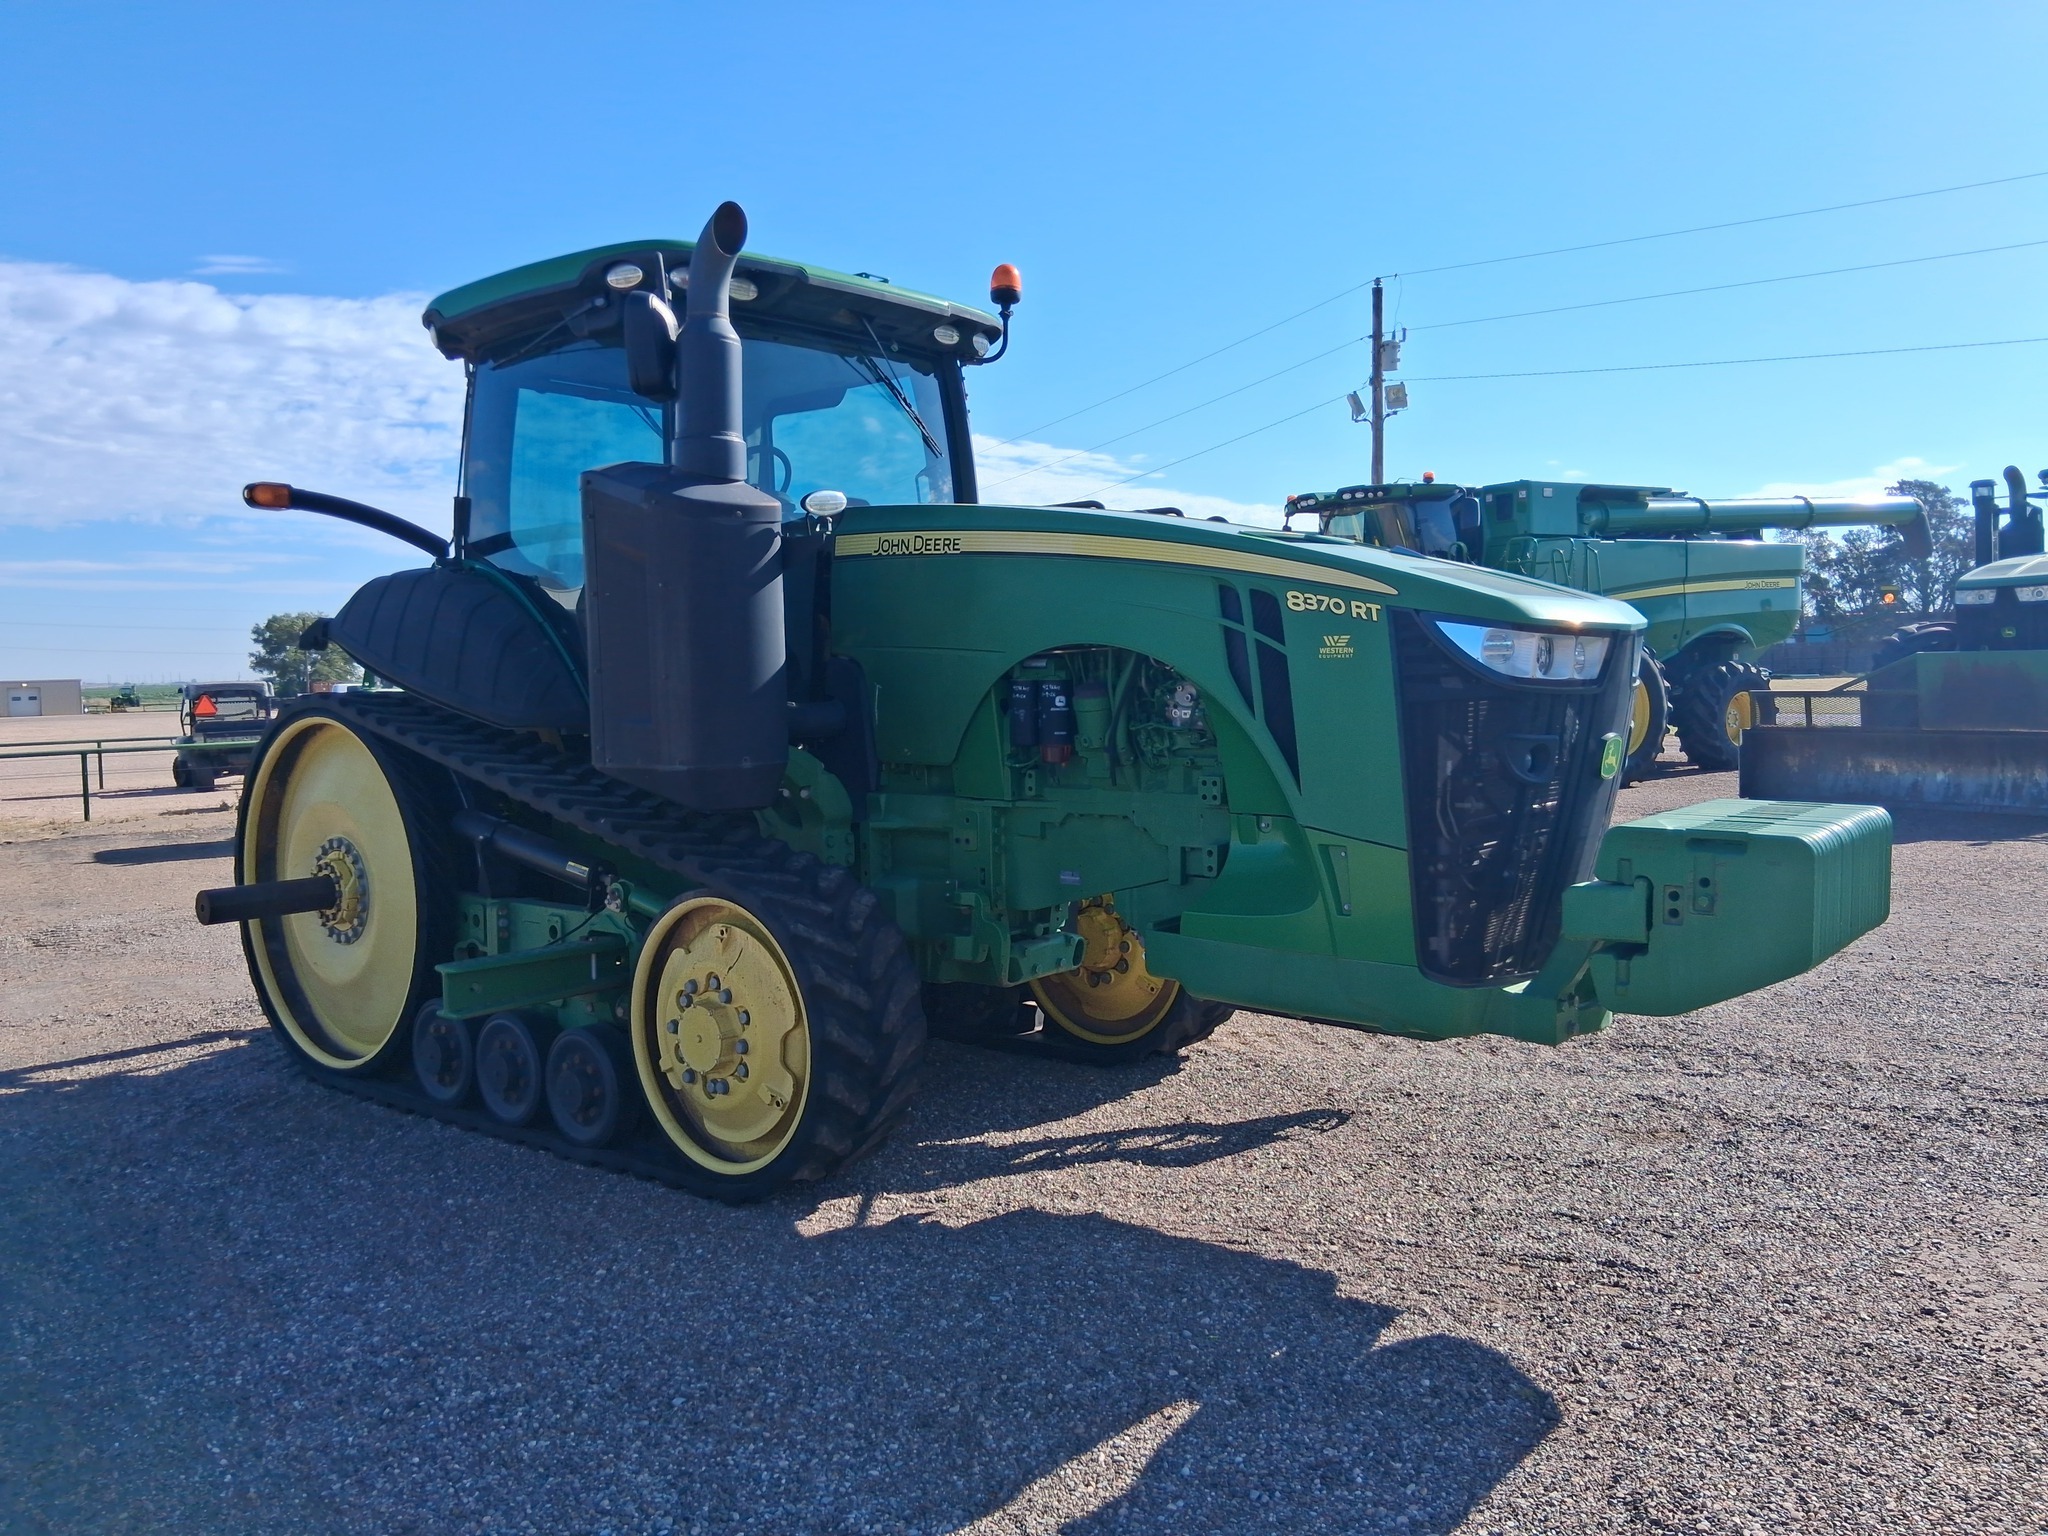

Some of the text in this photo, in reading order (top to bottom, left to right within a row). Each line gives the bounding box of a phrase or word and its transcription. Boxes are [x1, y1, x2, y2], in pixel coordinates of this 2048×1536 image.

[873, 535, 961, 554] JOHN DEERE
[1744, 580, 1780, 589] JOHN DEERE
[1286, 590, 1381, 621] 8370 RT
